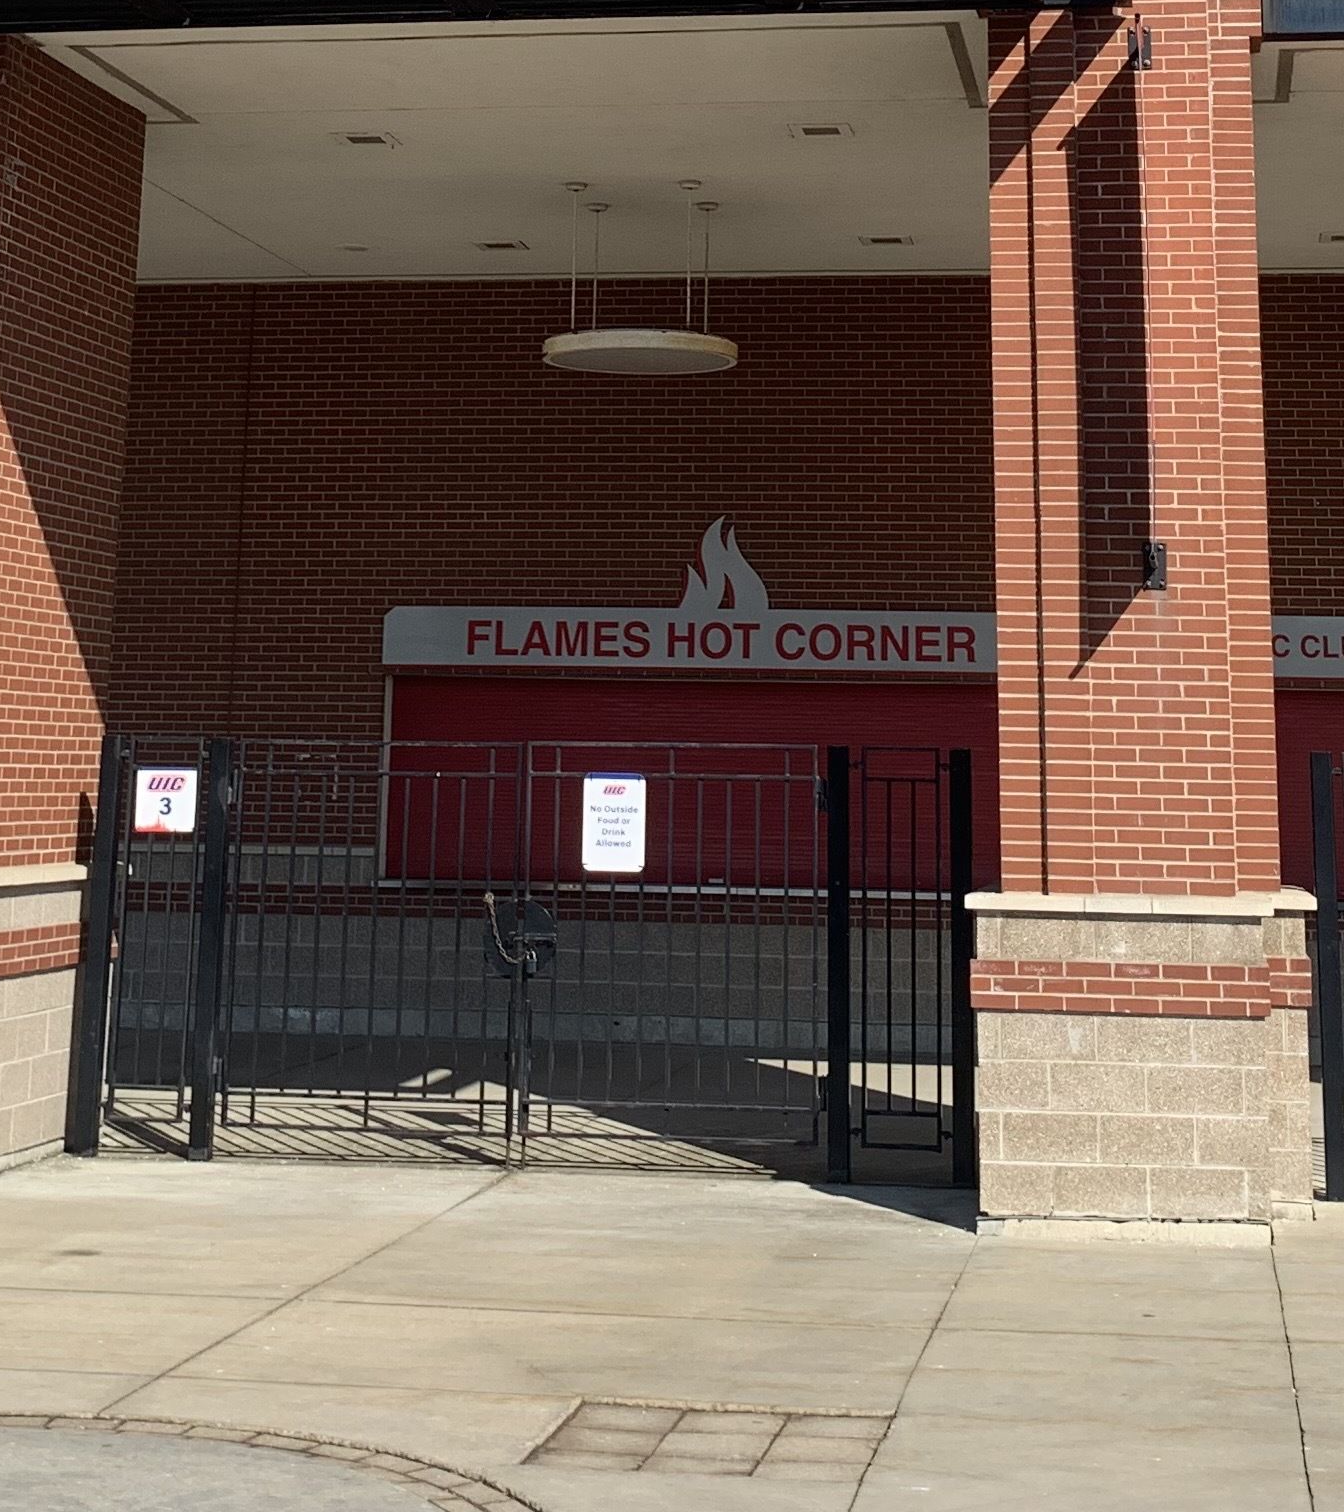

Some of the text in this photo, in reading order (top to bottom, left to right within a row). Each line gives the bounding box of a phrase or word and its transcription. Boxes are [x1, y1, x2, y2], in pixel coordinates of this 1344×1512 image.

[466, 619, 977, 663] FLAMES HOT CORNER
[147, 775, 186, 792] UIC
[602, 785, 627, 796] UIC
[159, 797, 172, 816] 3
[590, 805, 639, 814] No Outside
[597, 817, 620, 825] Food
[601, 828, 626, 836] Drink
[595, 839, 632, 848] Allowed
